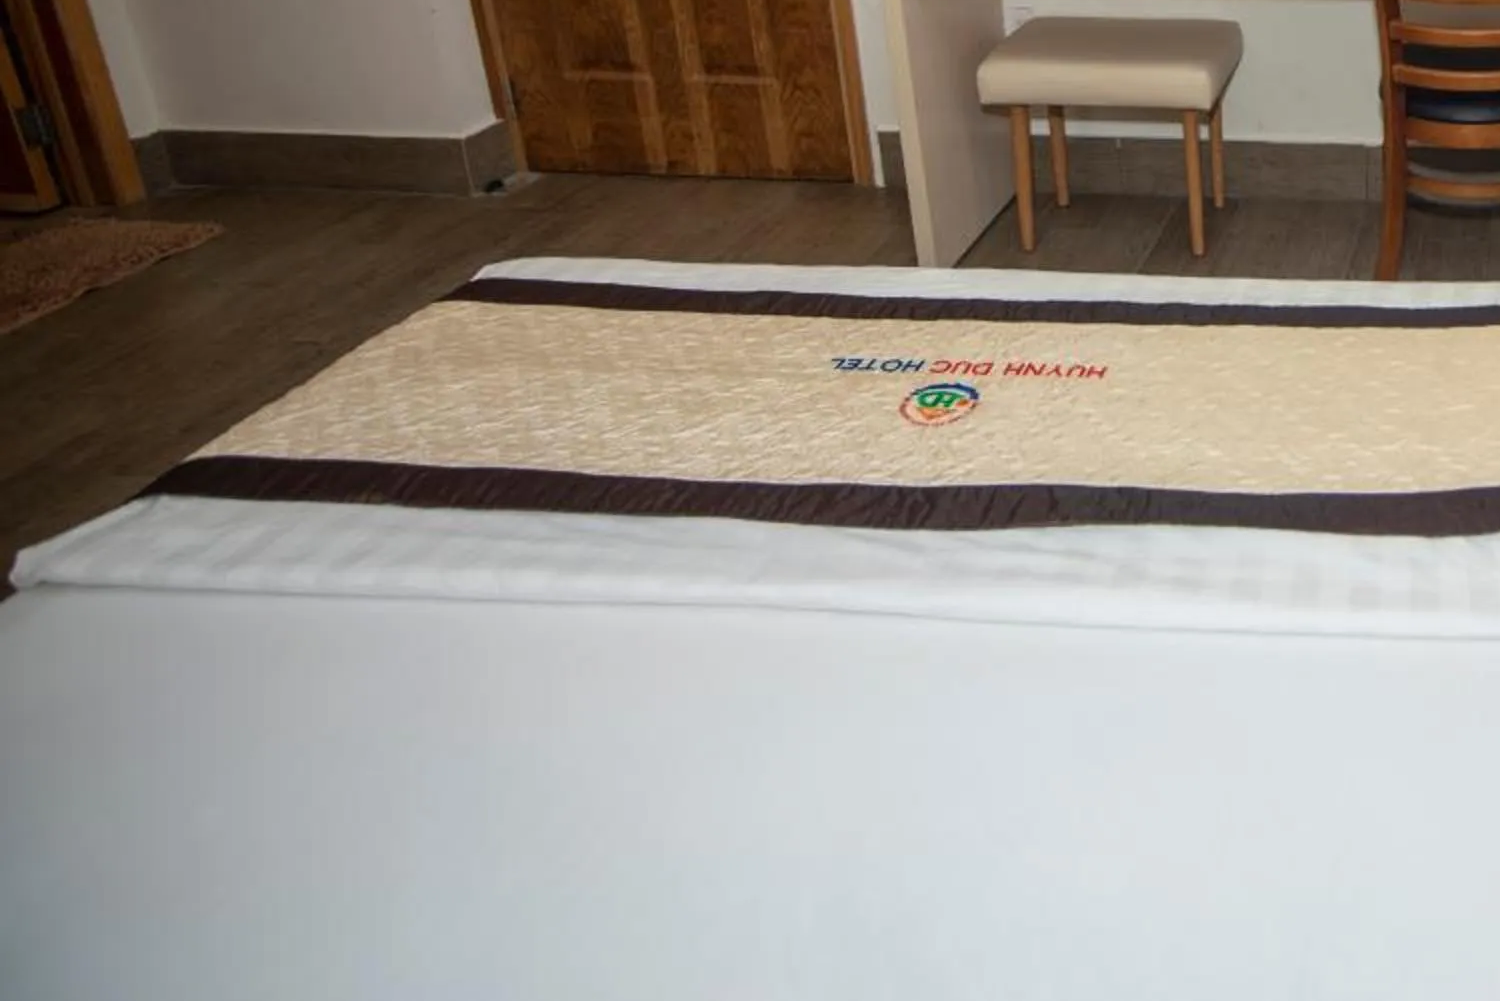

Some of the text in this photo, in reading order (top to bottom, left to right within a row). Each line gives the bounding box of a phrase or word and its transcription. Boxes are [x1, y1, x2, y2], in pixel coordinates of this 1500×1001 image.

[831, 357, 1108, 379] HUYNH DUC HOTEL
